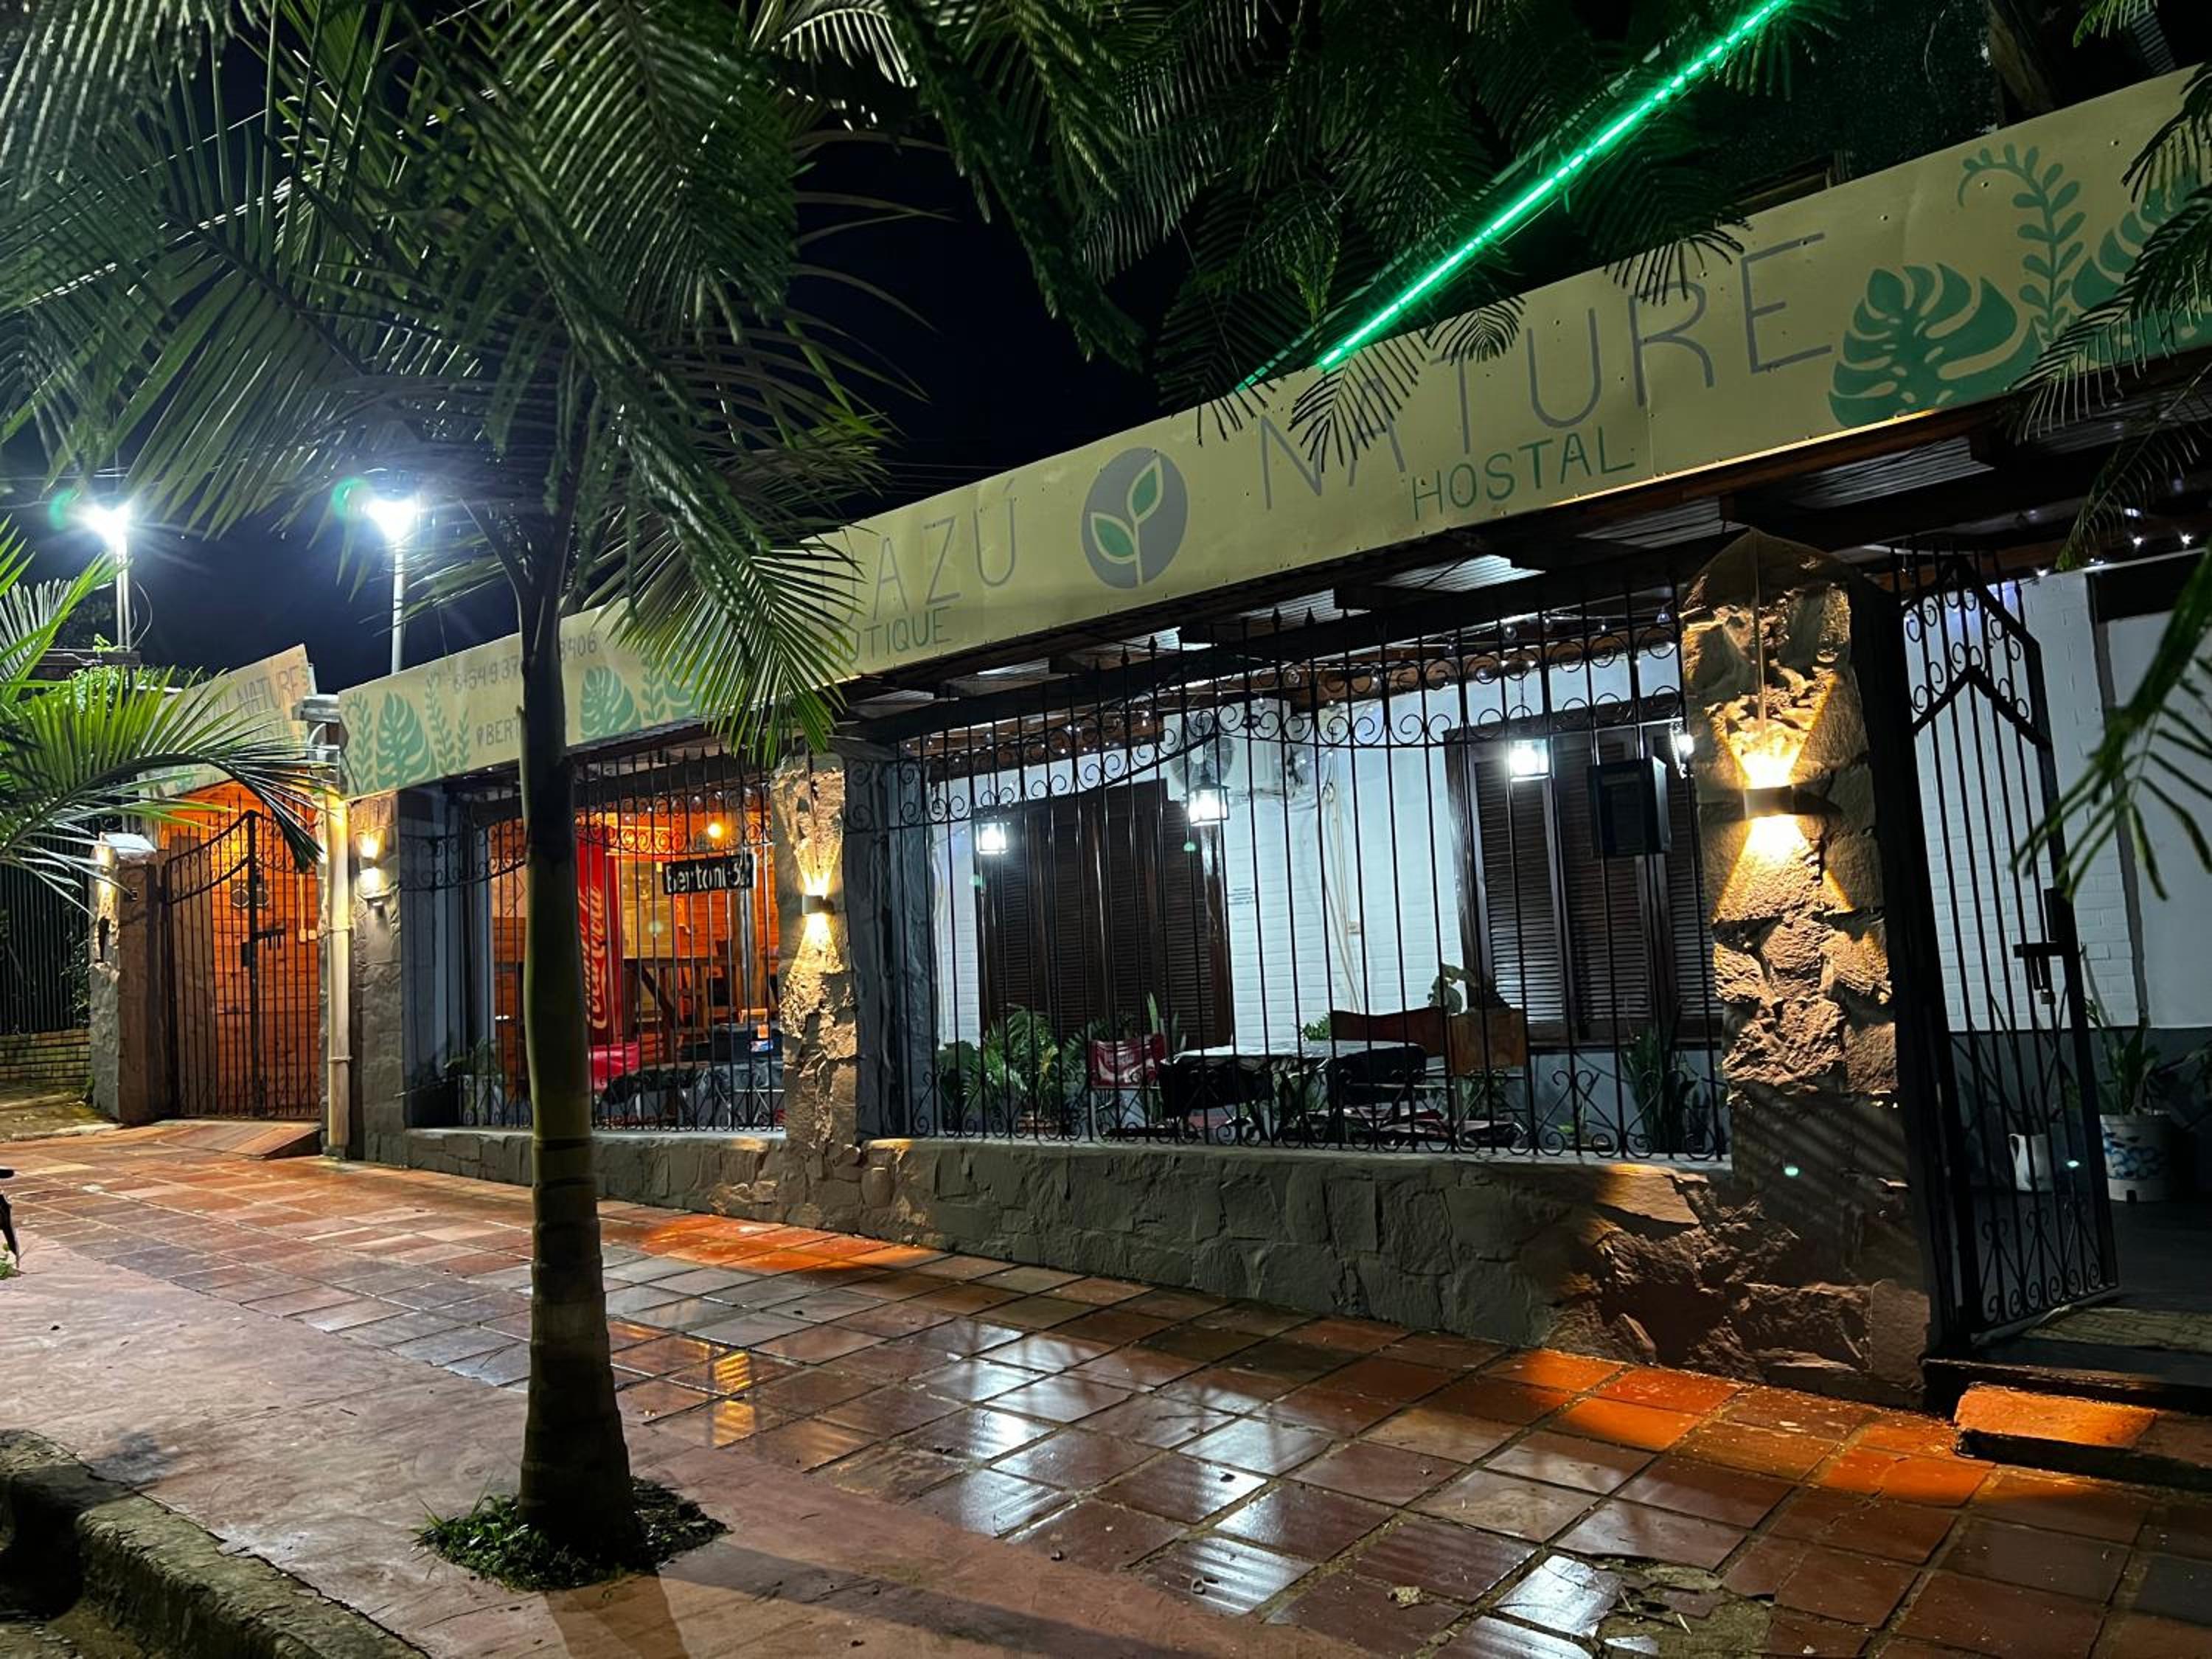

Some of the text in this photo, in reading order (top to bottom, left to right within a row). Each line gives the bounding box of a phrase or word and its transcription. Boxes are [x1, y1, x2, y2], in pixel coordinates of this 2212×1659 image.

[821, 232, 1833, 628] UAZÚ NATURE
[825, 426, 1636, 665] OUTIQUE HOSTAL
[486, 717, 521, 745] BERT
[578, 885, 608, 1030] Coca-Cola
